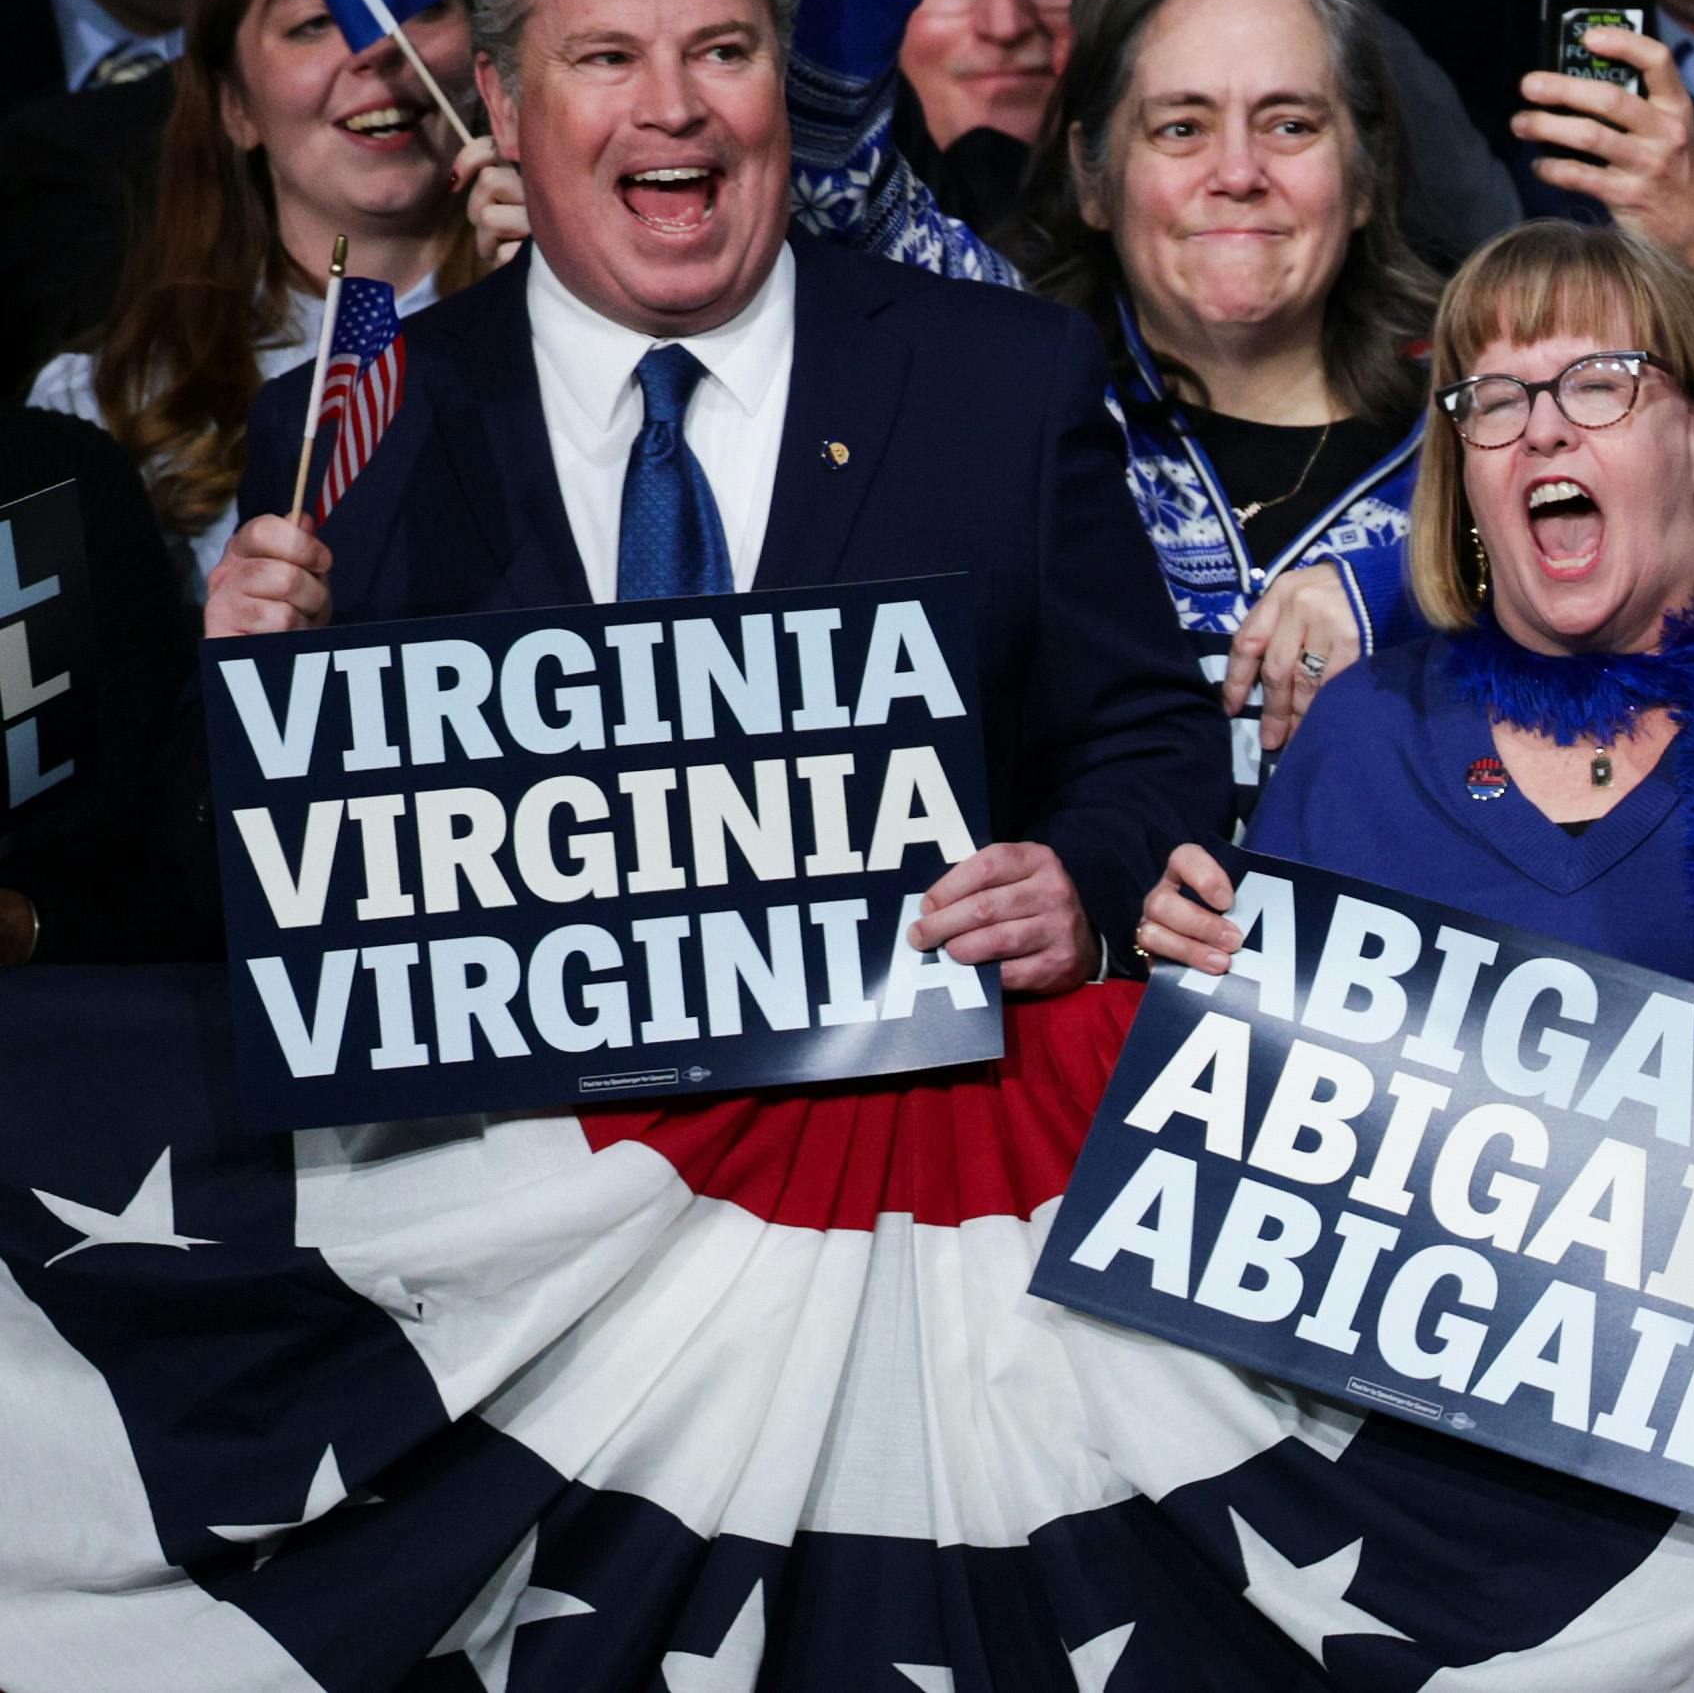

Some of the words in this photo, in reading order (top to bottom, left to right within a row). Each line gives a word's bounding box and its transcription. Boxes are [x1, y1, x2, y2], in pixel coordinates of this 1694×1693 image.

[217, 599, 967, 780] VIRGINIA
[232, 745, 980, 929] VIRGINIA
[246, 893, 987, 1079] VIRGINIA
